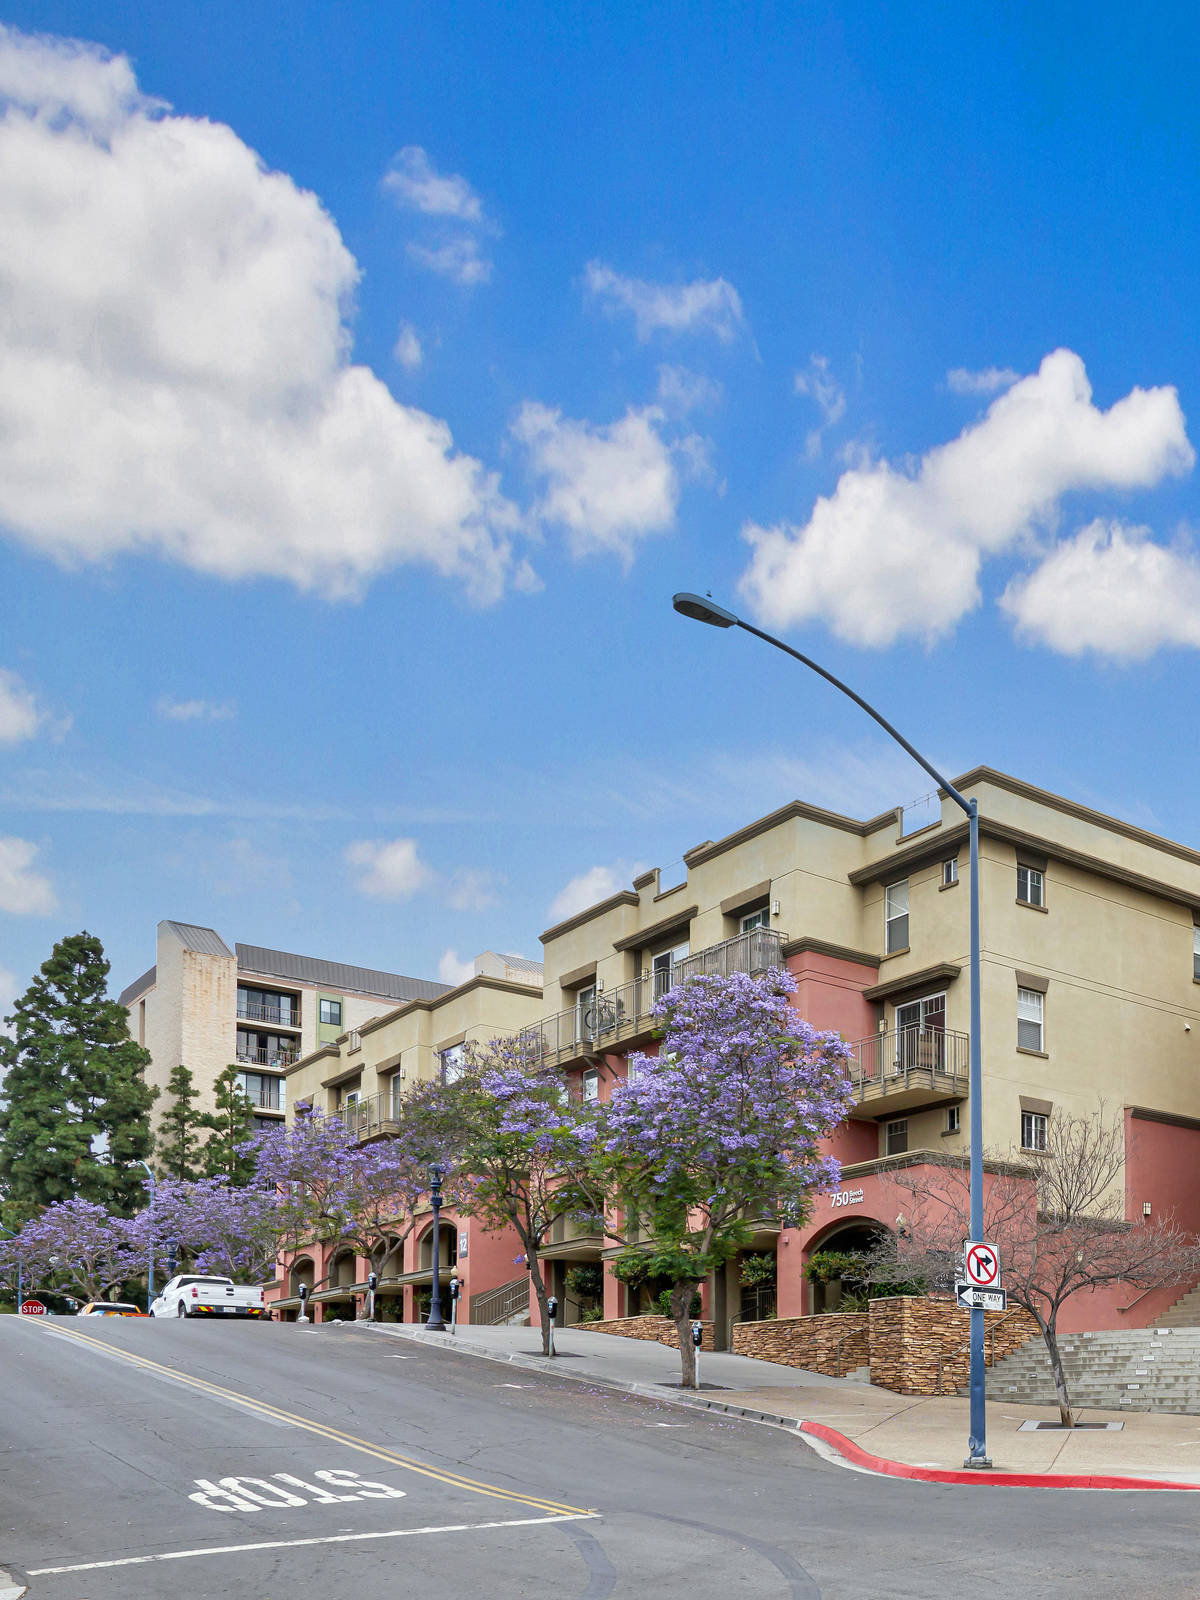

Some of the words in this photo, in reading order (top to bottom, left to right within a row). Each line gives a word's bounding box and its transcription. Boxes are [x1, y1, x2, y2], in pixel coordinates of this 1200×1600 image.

[830, 1191, 849, 1208] 750
[459, 1238, 467, 1252] 12
[972, 1293, 986, 1302] ONE
[988, 1293, 1002, 1303] WAY
[23, 1305, 43, 1313] STOP
[188, 1469, 407, 1512] STOP
